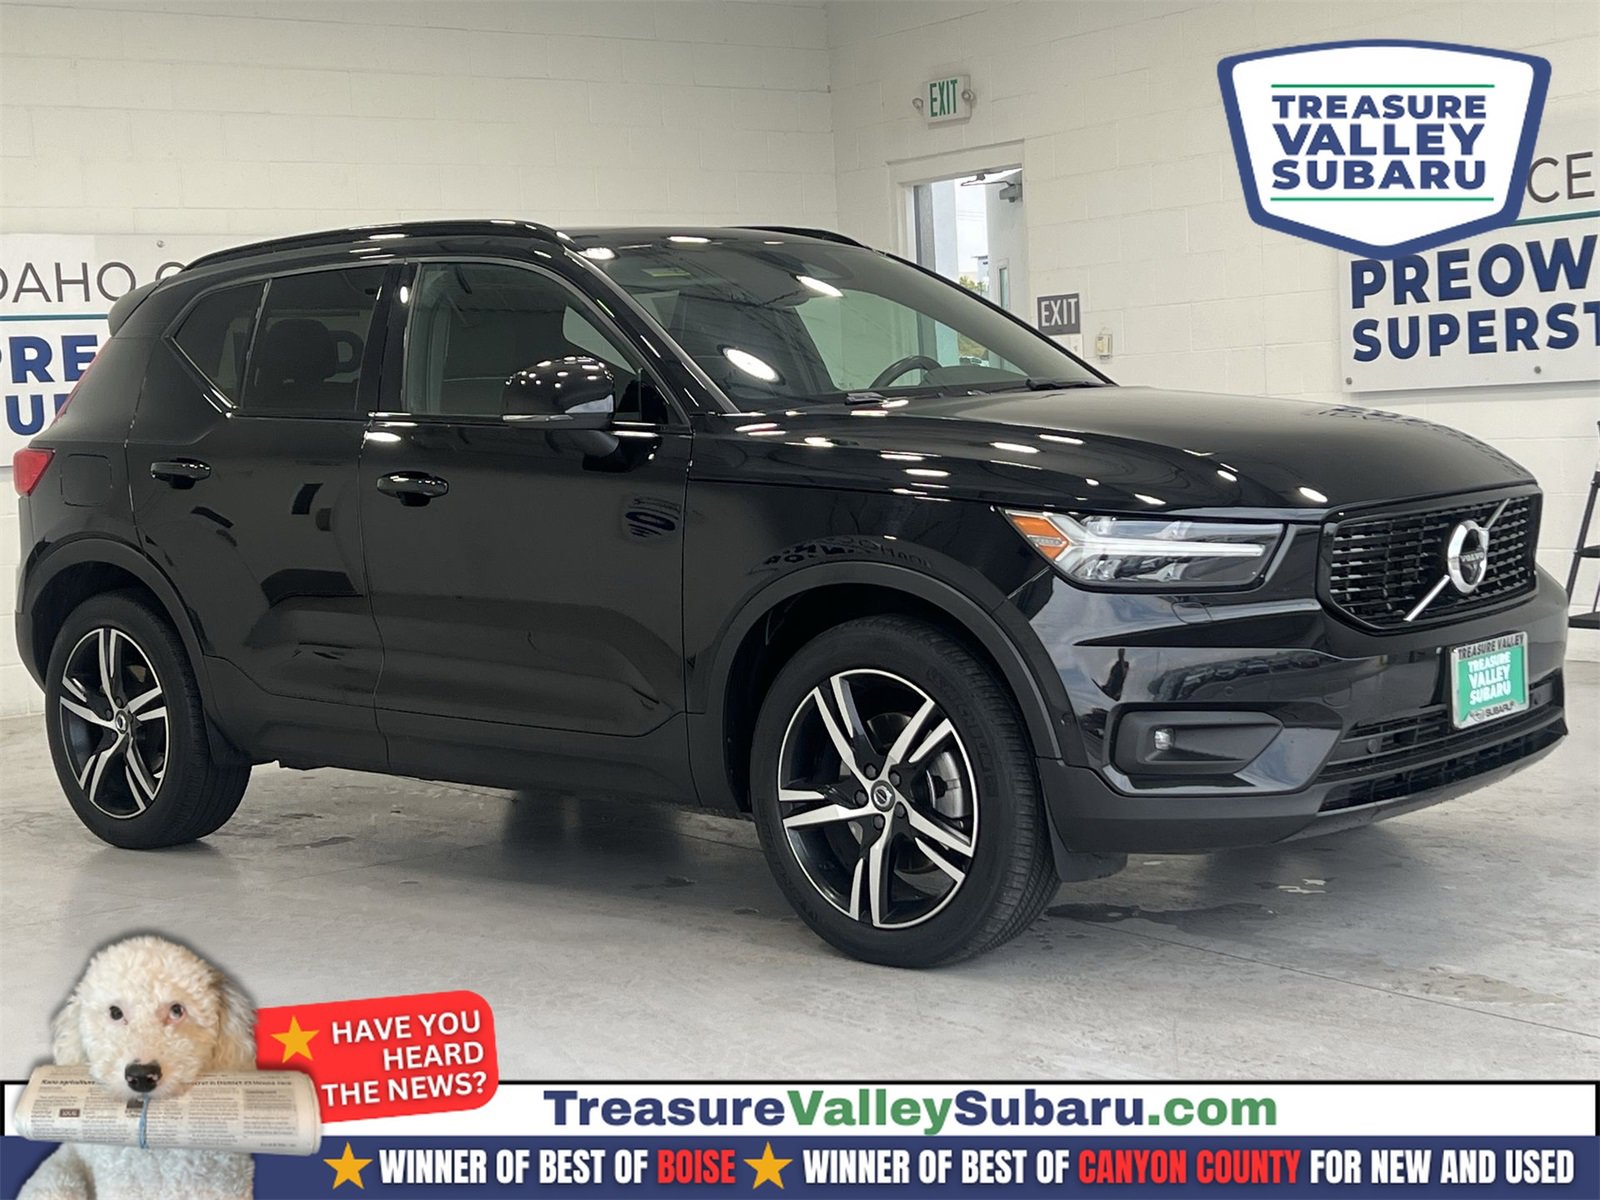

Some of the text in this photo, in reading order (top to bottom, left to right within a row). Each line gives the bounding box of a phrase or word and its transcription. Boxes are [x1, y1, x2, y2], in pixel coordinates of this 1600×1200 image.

[929, 79, 957, 117] EXIT
[1527, 151, 1595, 203] CE
[1351, 234, 1598, 309] PREOW
[1041, 298, 1079, 327] EXIT
[0, 335, 98, 383] RE
[1458, 633, 1525, 660] TREASURE VALLEY
[1468, 651, 1511, 673] TREASURE
[1468, 664, 1511, 689] VALLEY
[1469, 680, 1512, 705] SUBARU
